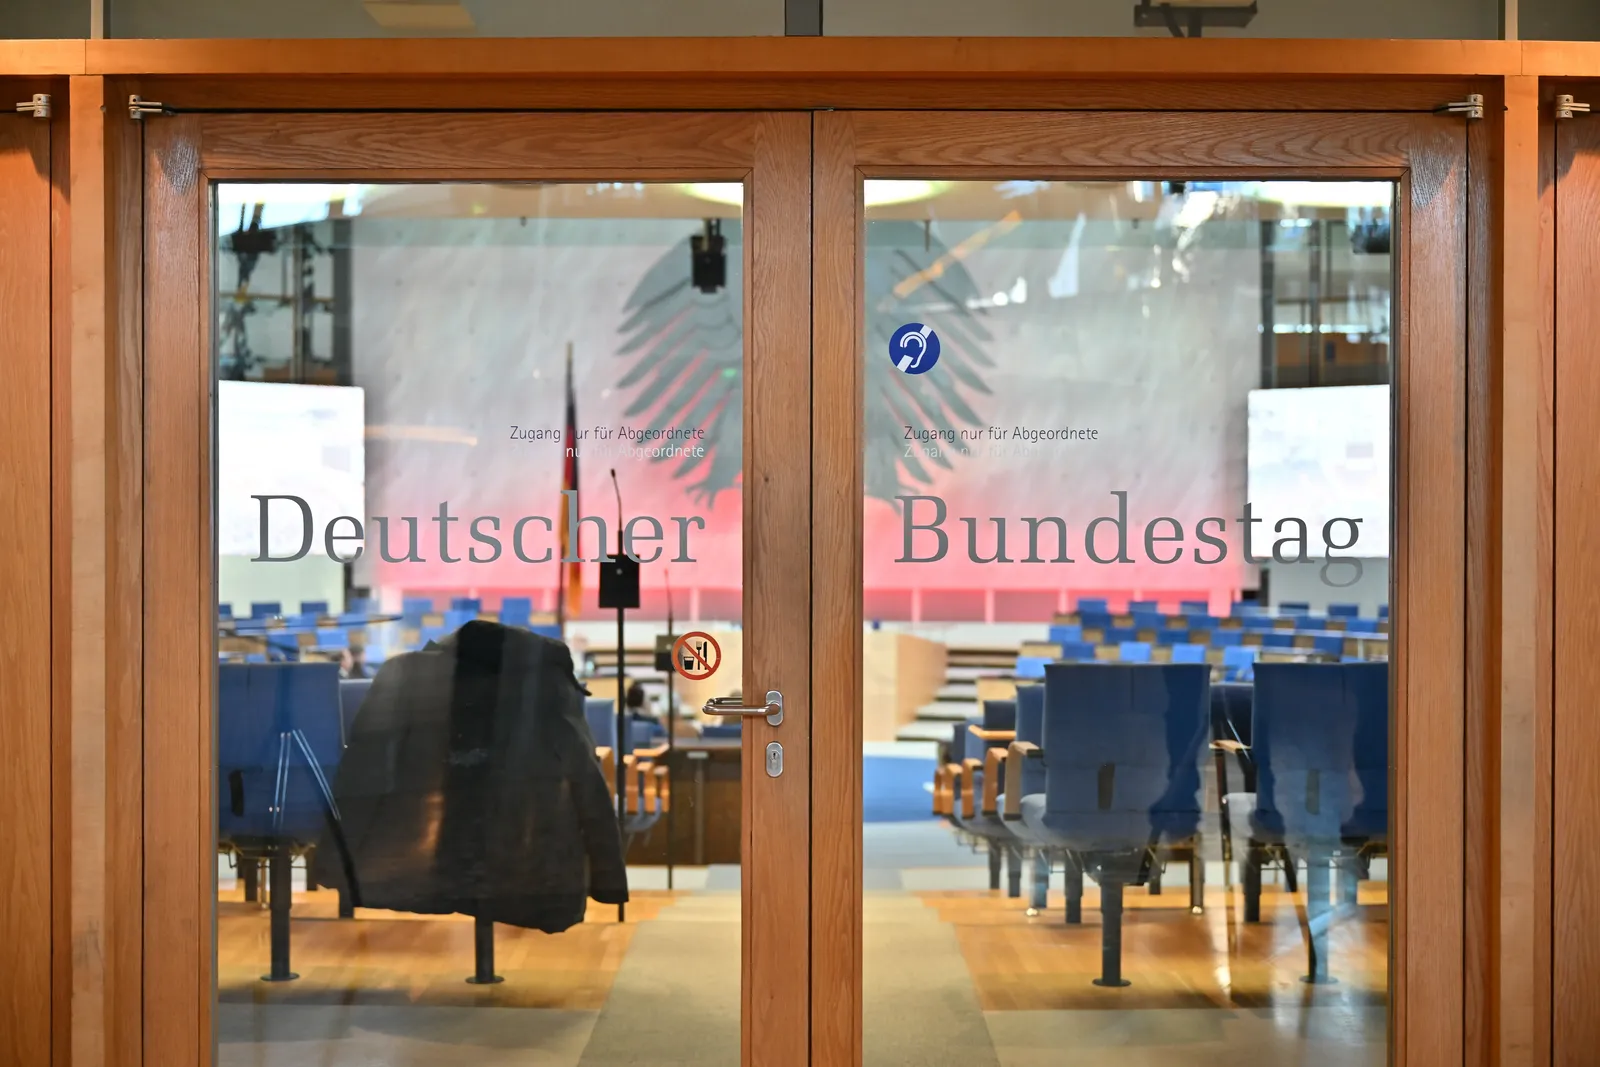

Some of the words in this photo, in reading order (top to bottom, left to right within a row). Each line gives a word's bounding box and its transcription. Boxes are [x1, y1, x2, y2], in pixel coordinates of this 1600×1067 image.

[509, 425, 561, 443] Zugang
[567, 428, 589, 440] ur
[594, 426, 613, 440] für
[617, 426, 705, 443] Abgeordnete
[904, 425, 955, 443] Zugang
[960, 429, 983, 440] nur
[988, 426, 1008, 440] für
[1012, 426, 1099, 443] Abgeordnete
[617, 444, 705, 461] Abgeordnete
[250, 489, 706, 564] Deutscher
[894, 490, 1364, 588] Bundestag
